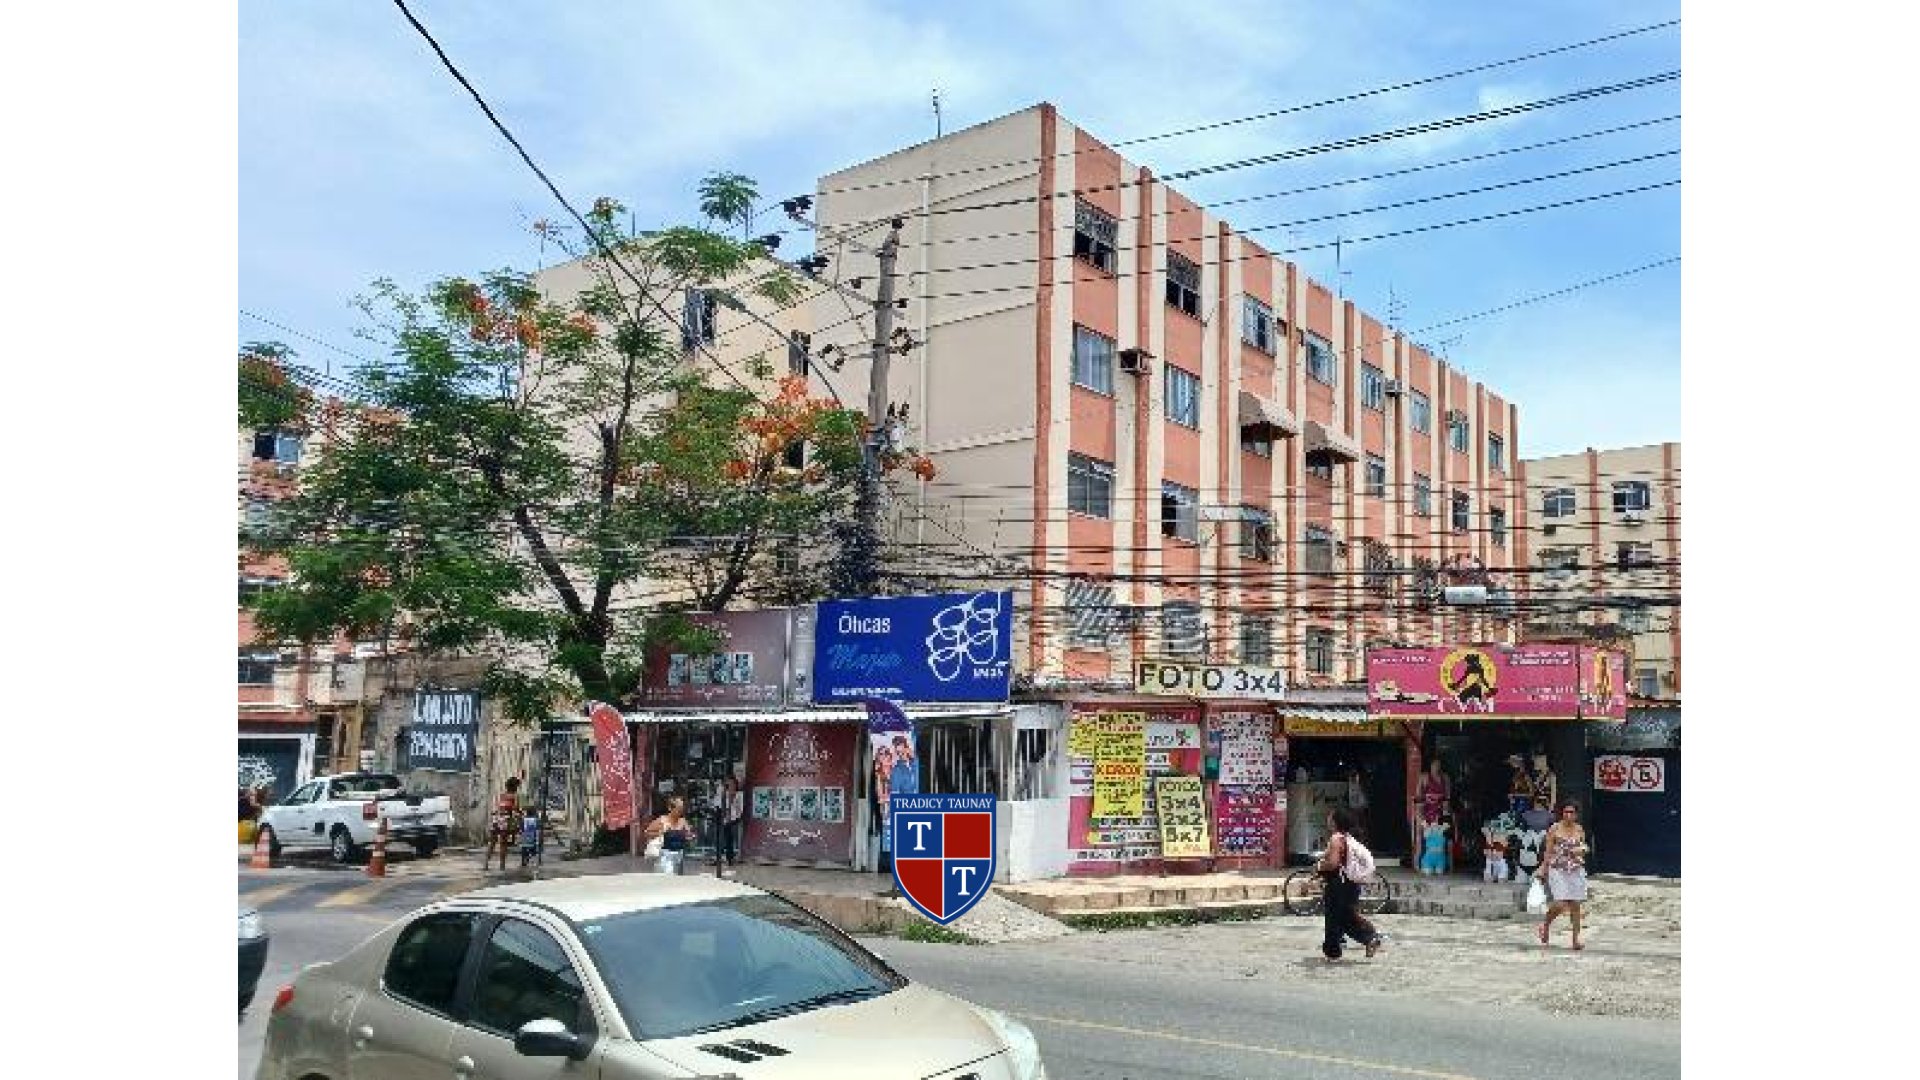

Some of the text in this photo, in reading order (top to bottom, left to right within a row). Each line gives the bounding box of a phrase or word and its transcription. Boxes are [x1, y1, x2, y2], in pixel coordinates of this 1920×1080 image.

[1139, 663, 1282, 693] FOTO 3x4
[1163, 812, 1203, 826] 2x2
[1165, 827, 1203, 843] 5x7
